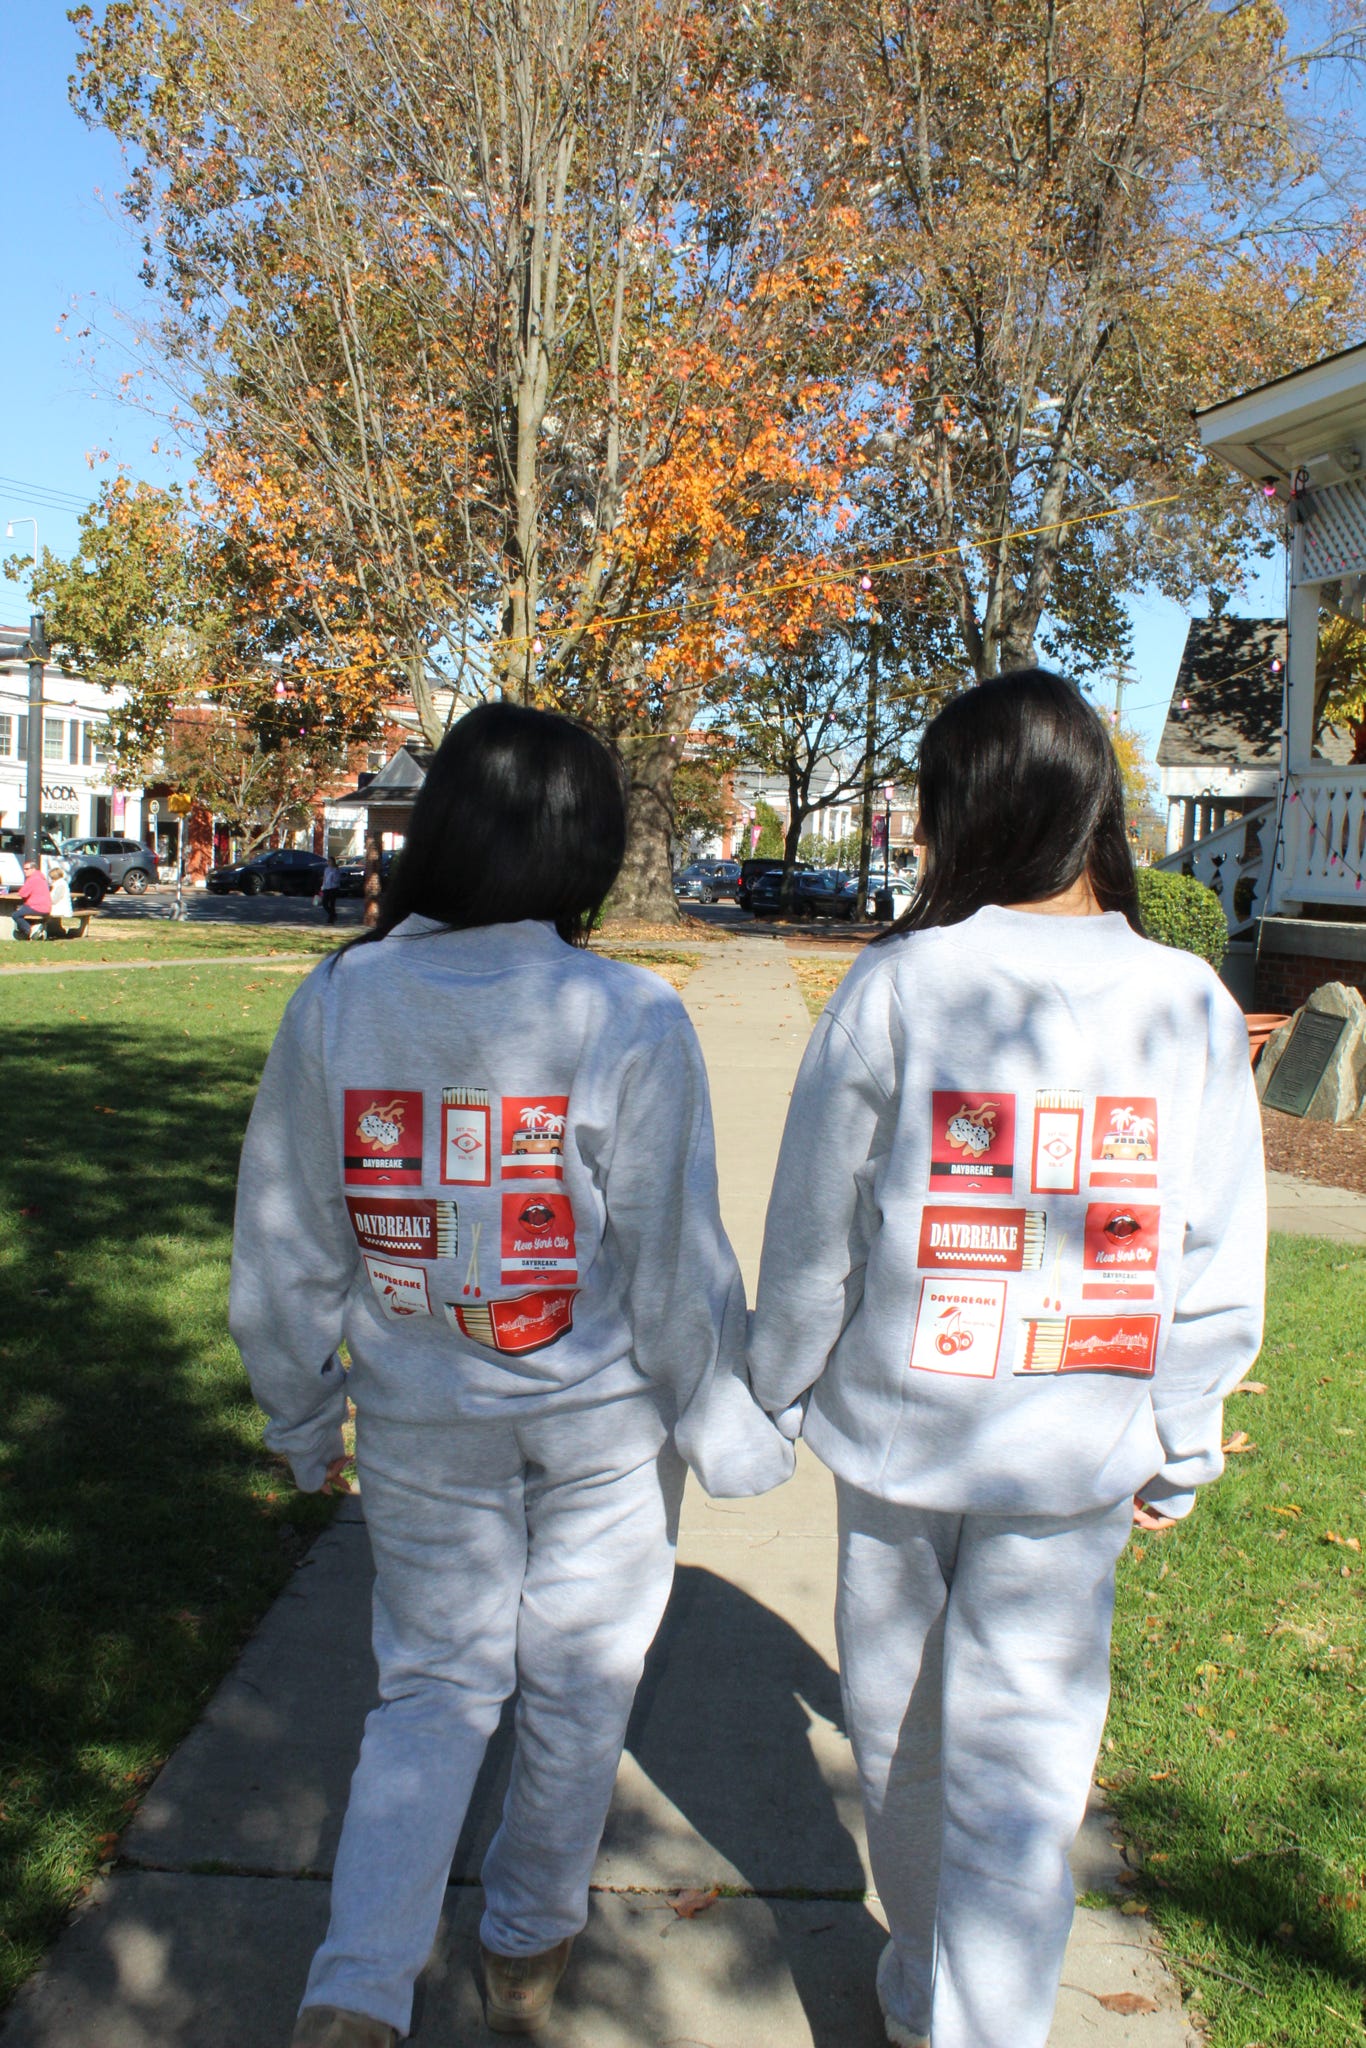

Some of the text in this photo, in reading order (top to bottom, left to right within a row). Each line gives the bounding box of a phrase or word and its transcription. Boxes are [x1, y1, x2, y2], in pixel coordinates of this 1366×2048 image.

[362, 1158, 403, 1169] DAYBREAKE
[950, 1164, 994, 1176] DAYBREAKE
[354, 1212, 431, 1238] DAYBREAKE
[513, 1235, 569, 1252] New York City
[929, 1223, 1018, 1251] DAYBREAKE
[1095, 1247, 1152, 1263] New York City
[373, 1270, 421, 1290] DAYBREAKE
[930, 1294, 997, 1306] DAYBREAKE
